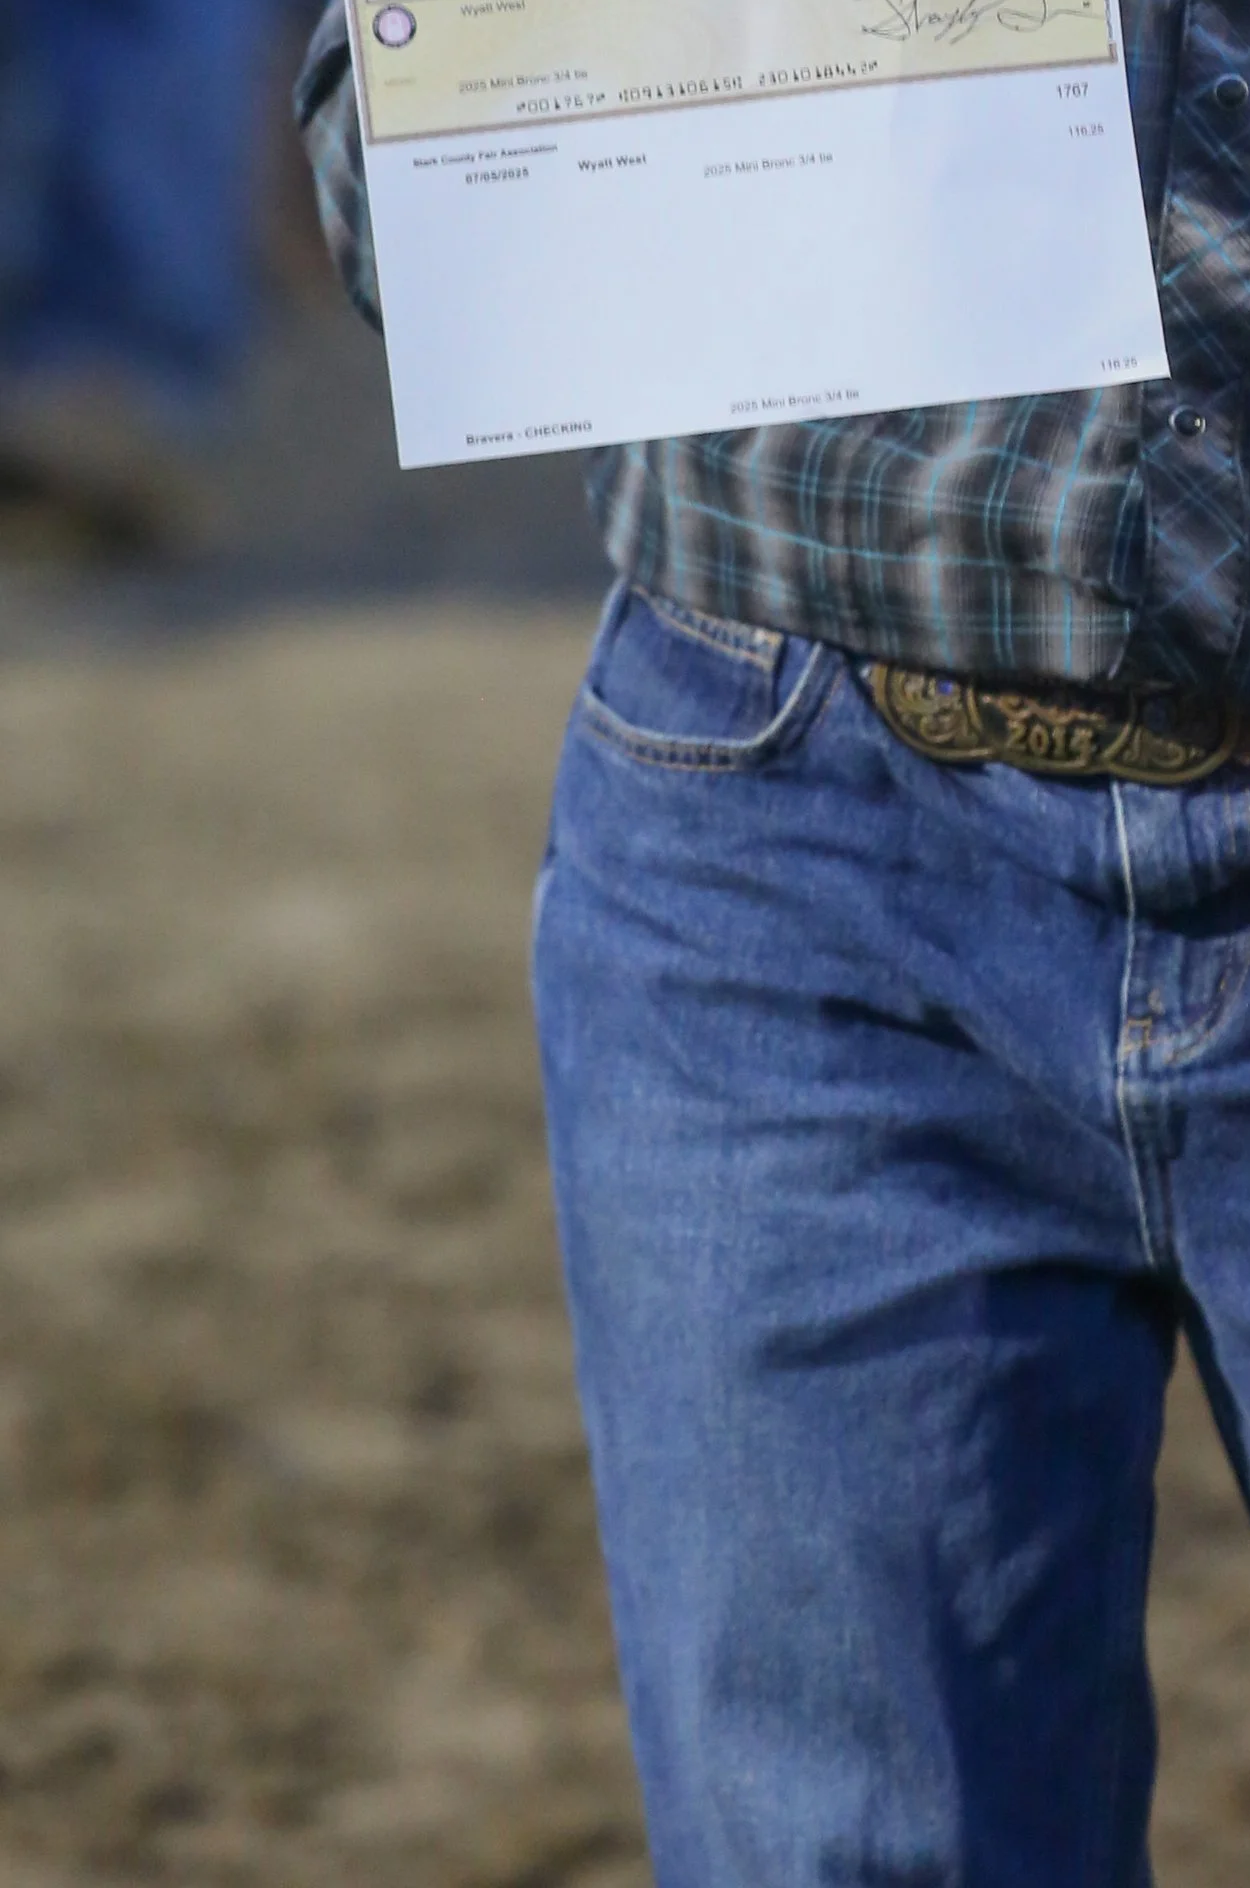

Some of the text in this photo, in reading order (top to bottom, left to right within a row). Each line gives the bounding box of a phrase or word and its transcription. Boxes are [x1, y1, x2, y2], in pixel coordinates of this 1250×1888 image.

[460, 2, 493, 17] Wyatt
[1057, 81, 1088, 99] 1767
[413, 158, 438, 167] Stark
[441, 154, 475, 166] County
[478, 150, 497, 161] Fair
[578, 158, 613, 172] Wyatt
[615, 154, 647, 167] West
[735, 160, 759, 174] Mini
[762, 398, 785, 410] Mini
[525, 420, 592, 439] CHECKING
